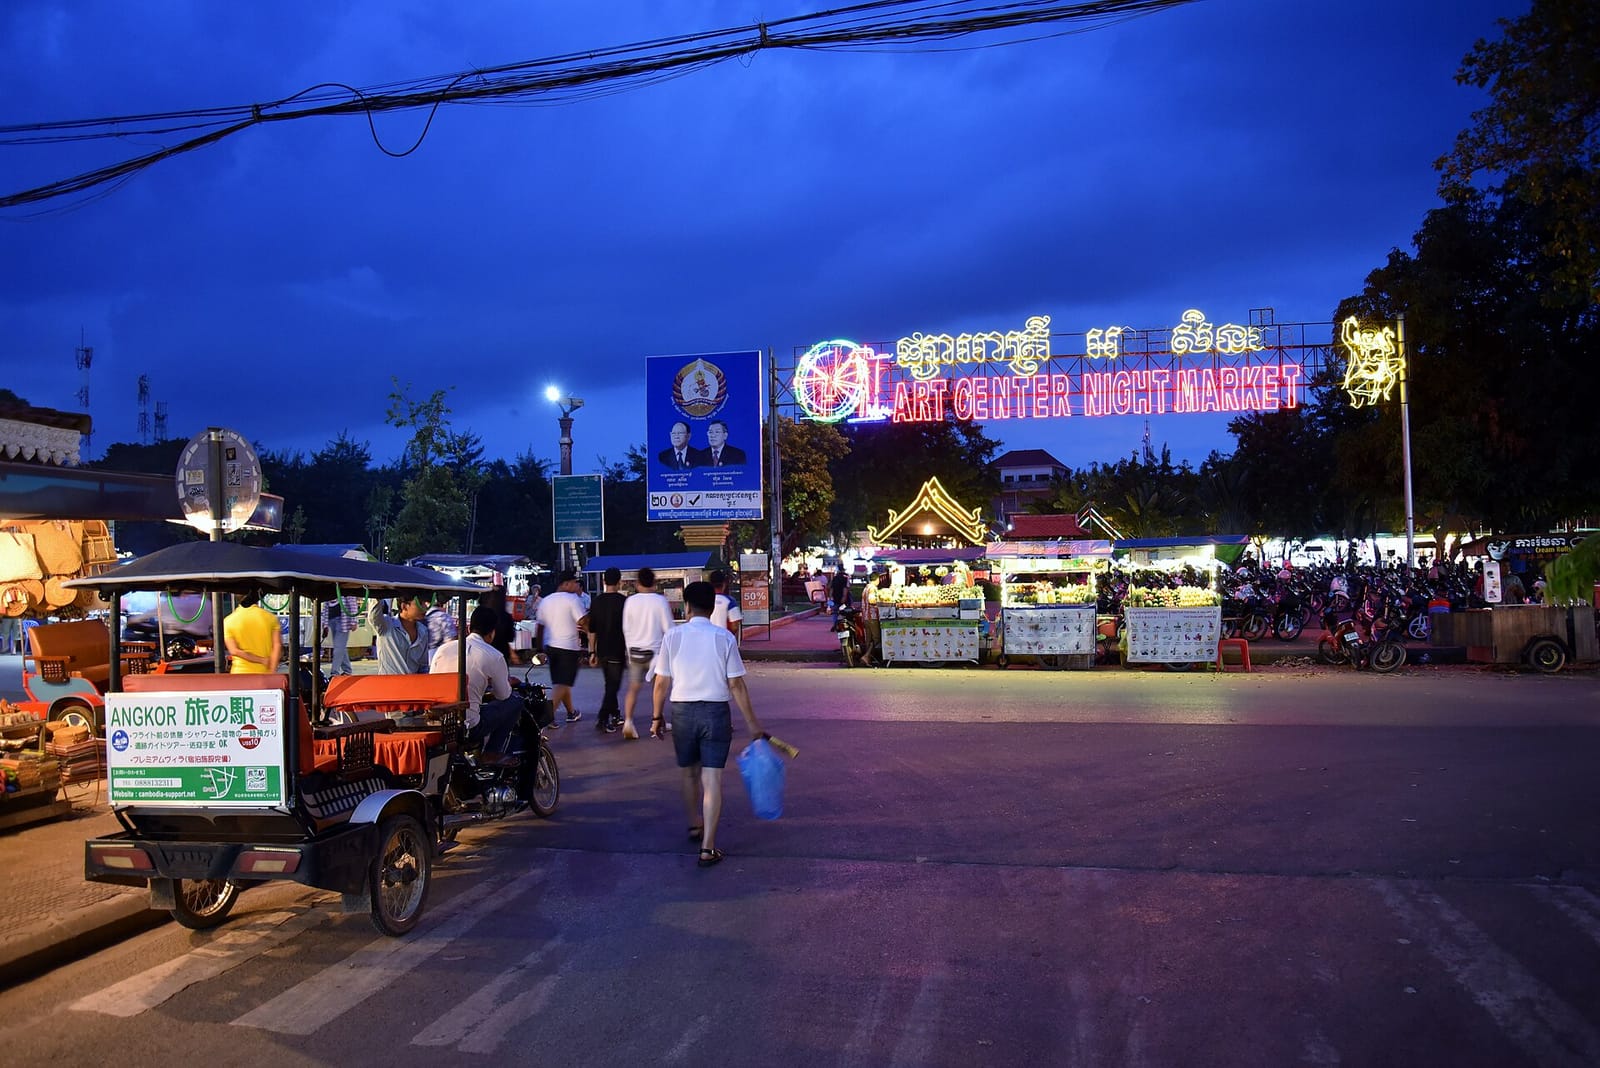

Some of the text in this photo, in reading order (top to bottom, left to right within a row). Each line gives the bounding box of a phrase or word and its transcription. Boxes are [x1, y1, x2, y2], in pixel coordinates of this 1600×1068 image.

[893, 364, 1300, 422] ART CENTER NIGHT MARKET
[744, 592, 766, 601] 50%
[111, 697, 255, 727] ANGKOR 旅の駅
[219, 739, 228, 748] OK
[113, 790, 134, 798] Website
[138, 790, 196, 799] cambodia-support.net
